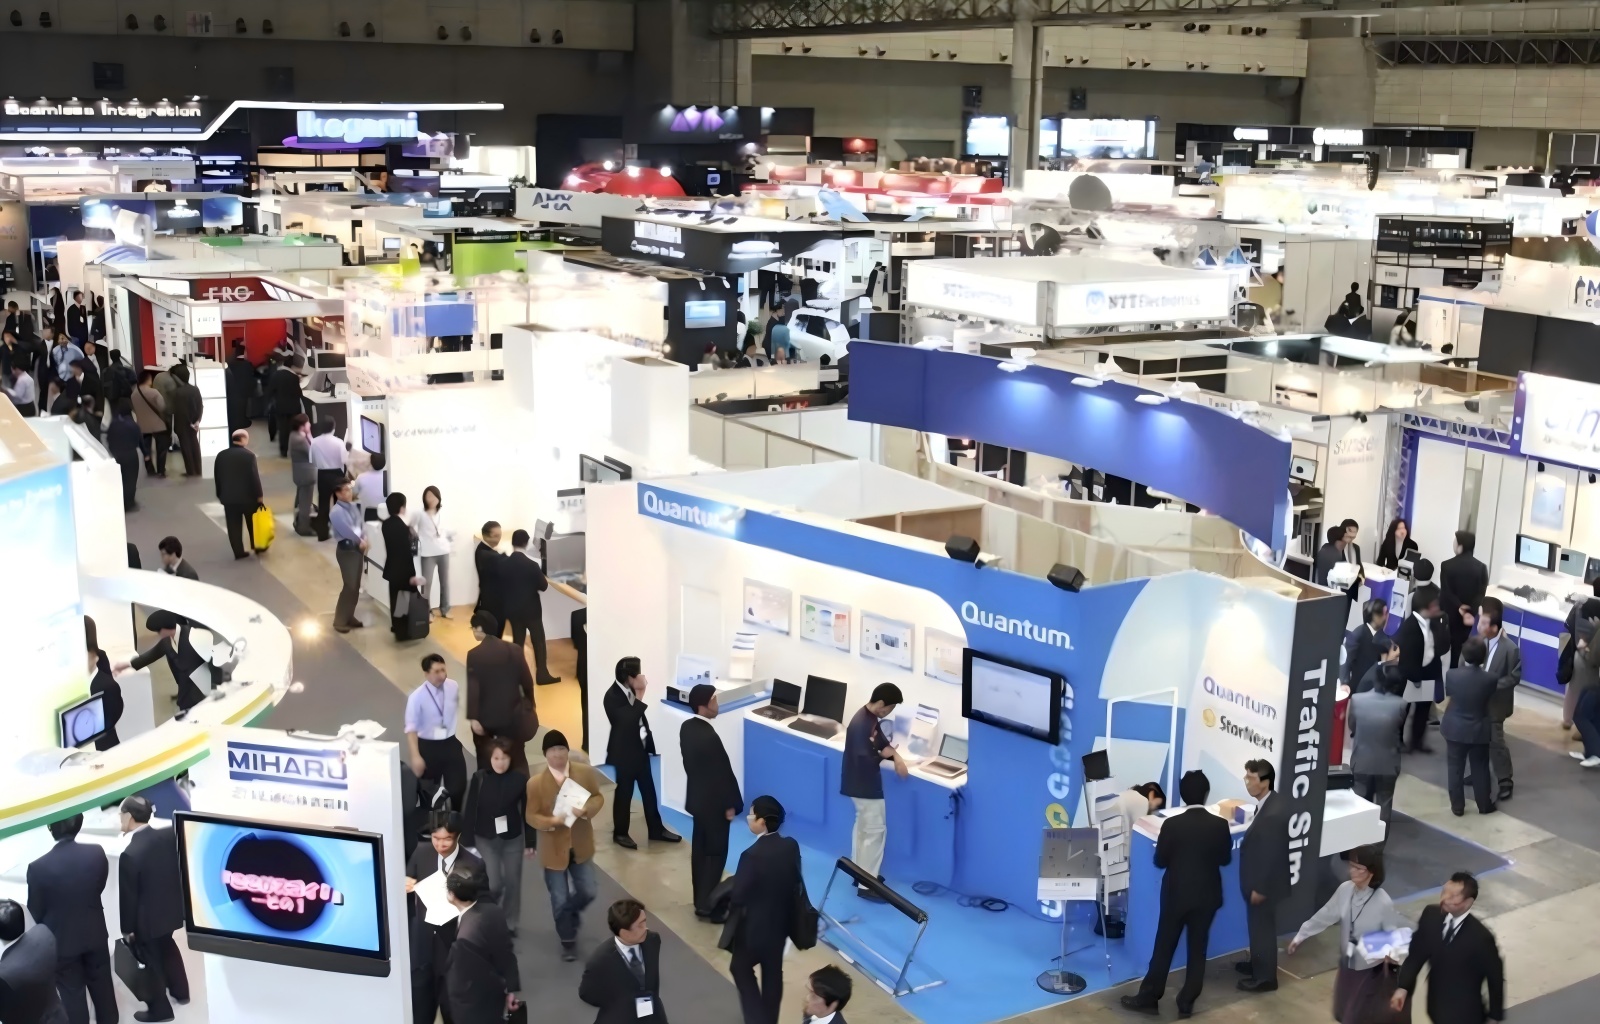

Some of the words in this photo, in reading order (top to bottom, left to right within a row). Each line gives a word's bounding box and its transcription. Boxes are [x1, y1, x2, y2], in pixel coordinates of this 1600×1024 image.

[101, 102, 202, 119] Integration
[1108, 294, 1137, 309] NTT
[1292, 658, 1328, 799] Traffic
[227, 749, 348, 780] MIHARU
[1287, 811, 1312, 886] Sim
